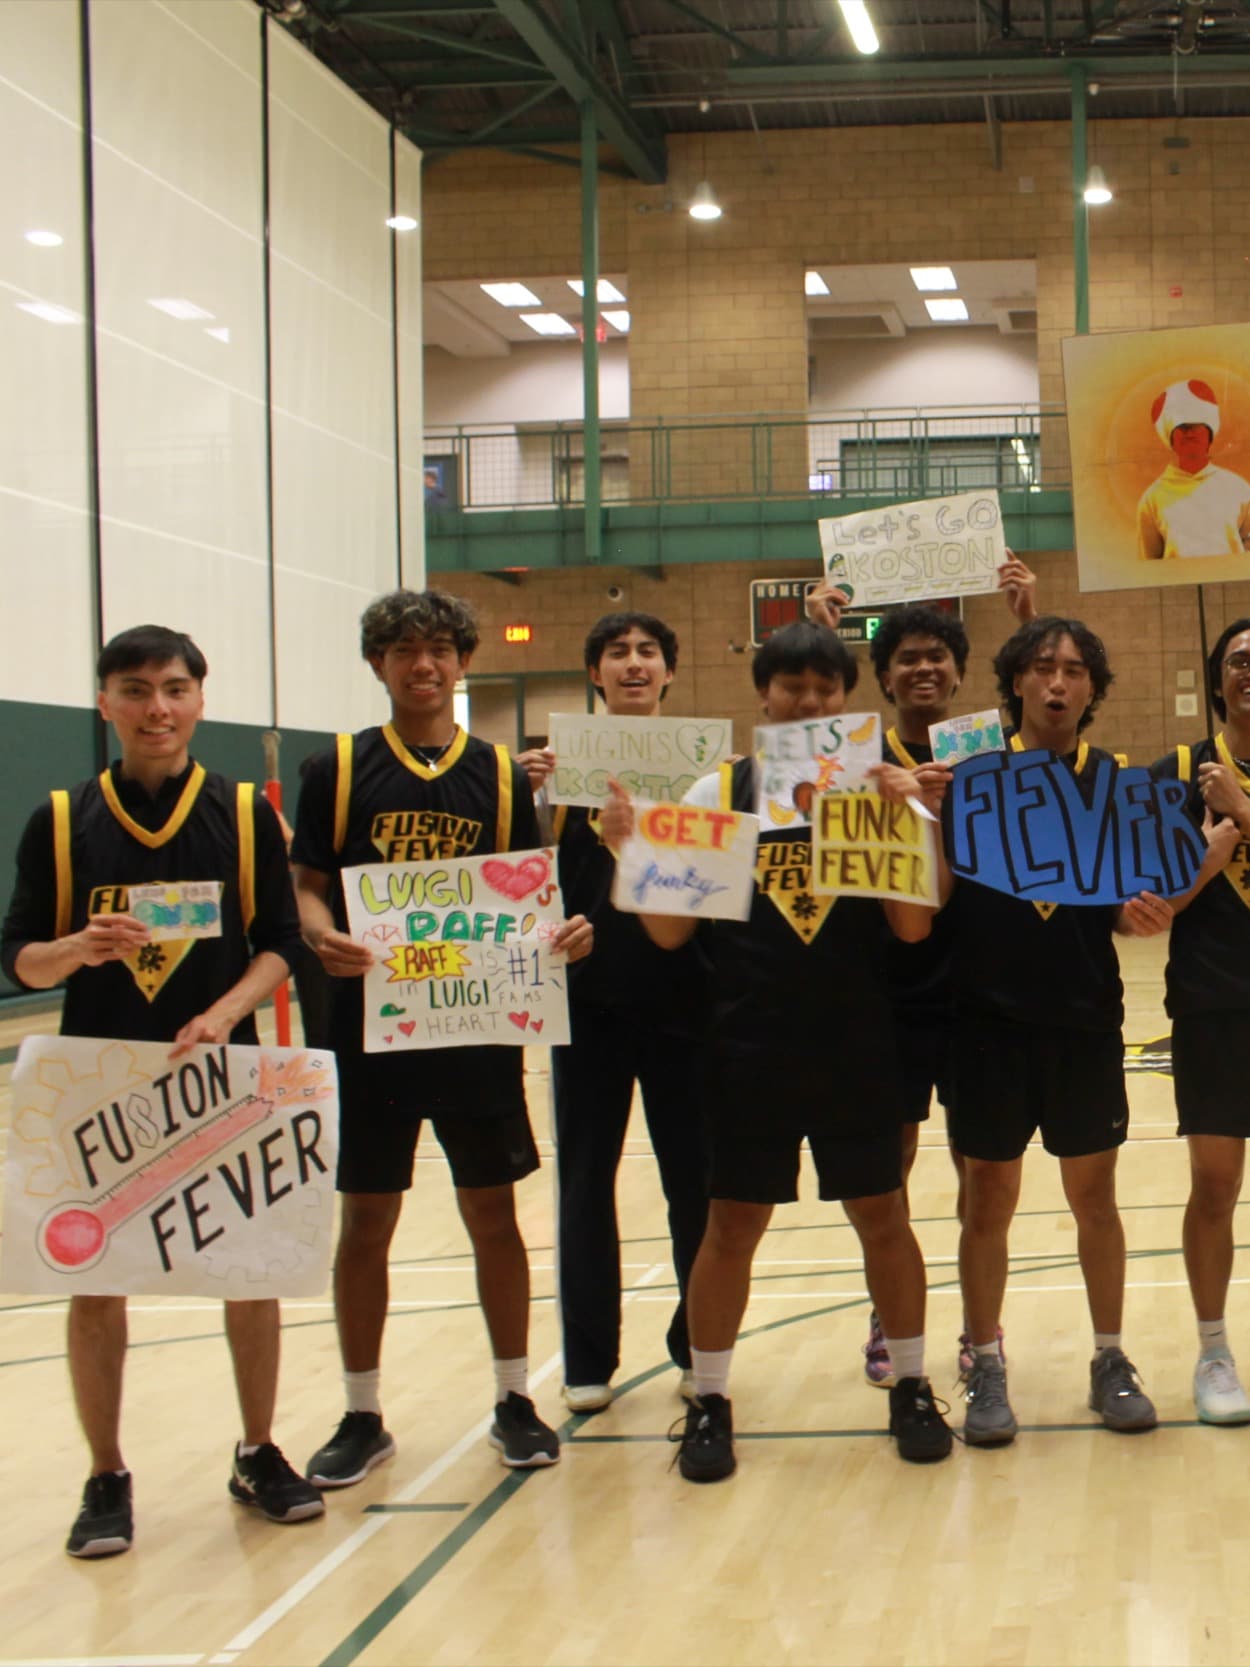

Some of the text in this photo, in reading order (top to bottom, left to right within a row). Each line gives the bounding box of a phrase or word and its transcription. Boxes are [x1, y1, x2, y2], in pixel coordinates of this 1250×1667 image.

[832, 499, 999, 547] Let's GO
[844, 536, 996, 582] KOSTON
[757, 584, 800, 598] HOME
[554, 768, 698, 803] KOSTO
[374, 812, 481, 844] FUSION
[649, 808, 736, 849] GET
[950, 749, 1206, 900] FEVER
[755, 844, 812, 867] FUSI
[820, 849, 929, 898] FEVER
[359, 868, 473, 915] LUIGI
[763, 868, 808, 891] FEV
[403, 944, 447, 975] RAFF
[507, 947, 545, 987] #1
[429, 978, 490, 1009] LUIGI
[425, 1010, 501, 1040] HEART
[73, 1046, 232, 1188] FUSION
[150, 1110, 329, 1273] FEVER
